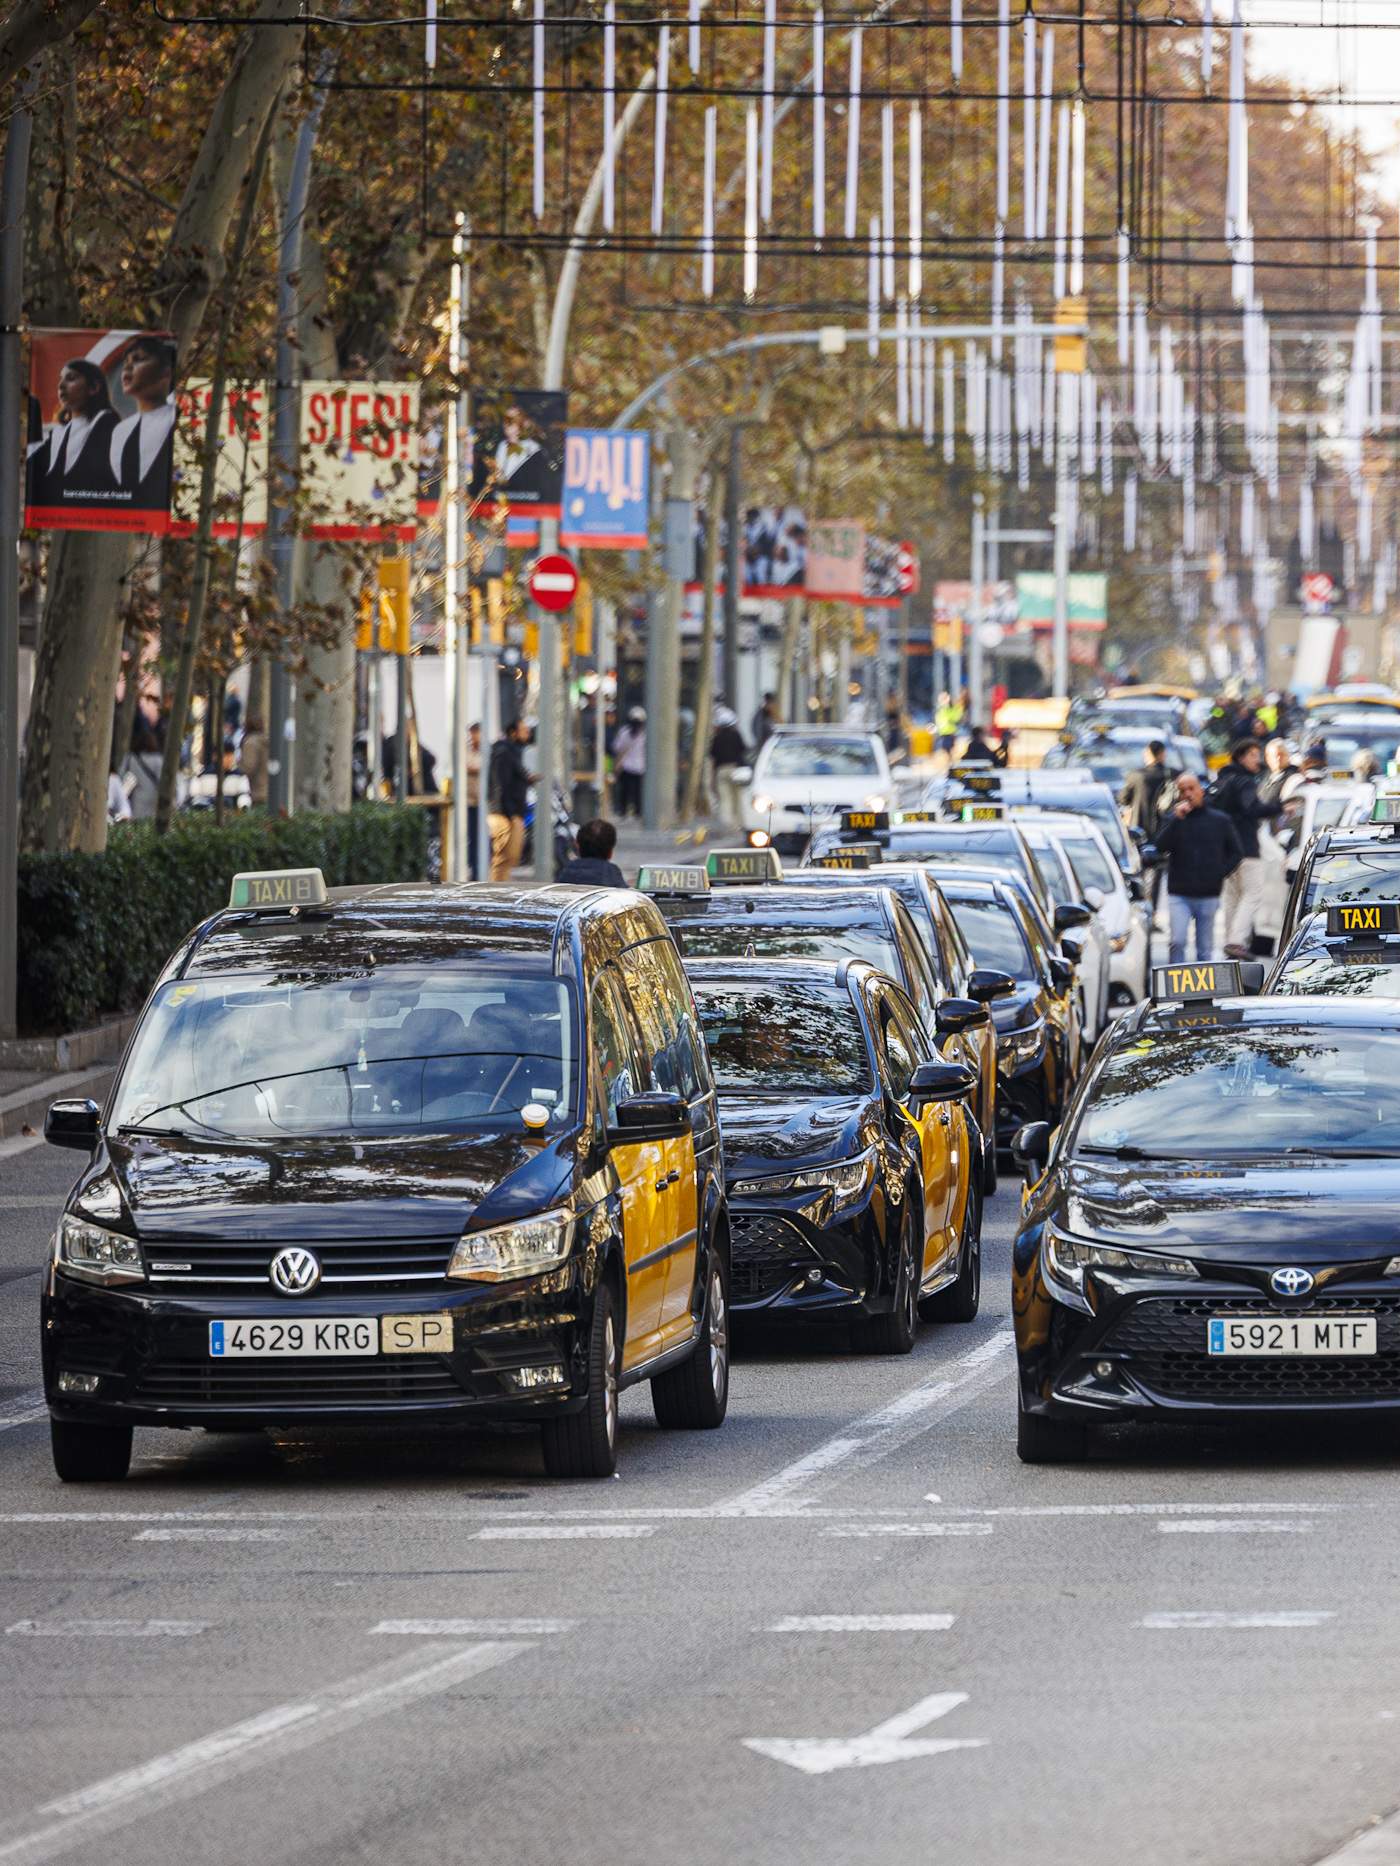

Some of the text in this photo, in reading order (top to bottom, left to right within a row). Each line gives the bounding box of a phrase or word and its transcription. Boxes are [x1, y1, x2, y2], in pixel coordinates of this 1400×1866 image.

[308, 392, 410, 460] STES!
[849, 813, 875, 828] TAXI
[721, 857, 754, 874] TAXI
[653, 870, 684, 888] TAXI
[251, 880, 292, 903] TAXI
[1341, 907, 1381, 929] TAXI
[1168, 966, 1215, 993] TAXI
[231, 1325, 303, 1350] 4629
[315, 1324, 370, 1350] KRG
[393, 1321, 442, 1348] SP
[1230, 1324, 1299, 1349] 5921
[1315, 1323, 1368, 1349] MTF
